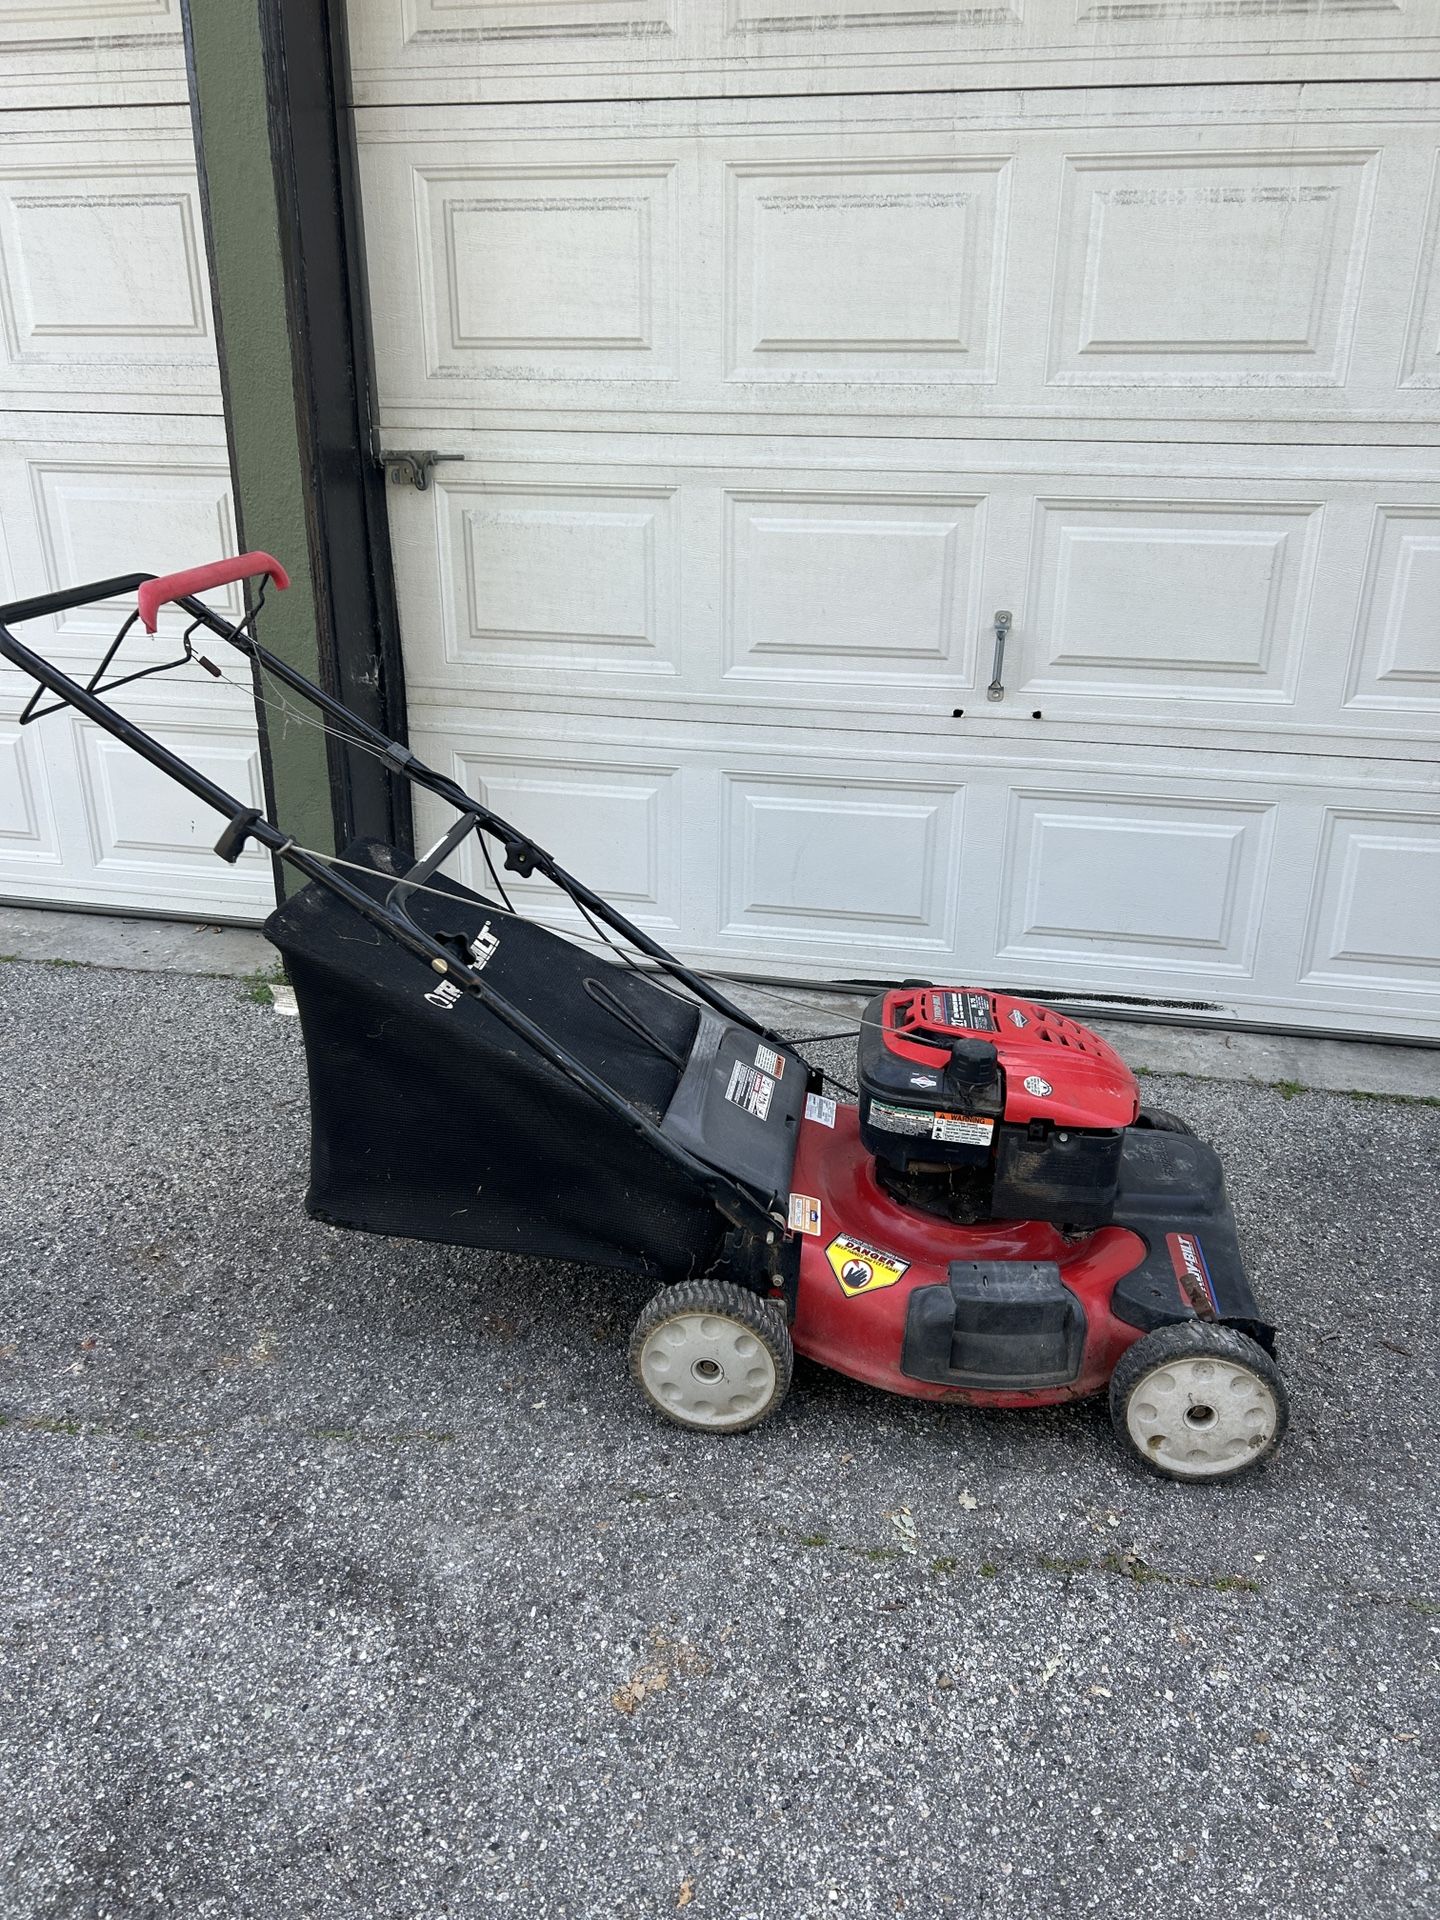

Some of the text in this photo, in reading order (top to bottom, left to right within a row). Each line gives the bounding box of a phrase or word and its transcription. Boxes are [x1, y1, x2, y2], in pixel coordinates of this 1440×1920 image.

[950, 1114, 985, 1125] WARNING
[845, 1241, 896, 1267] DANGER
[847, 1248, 863, 1258] HANDS
